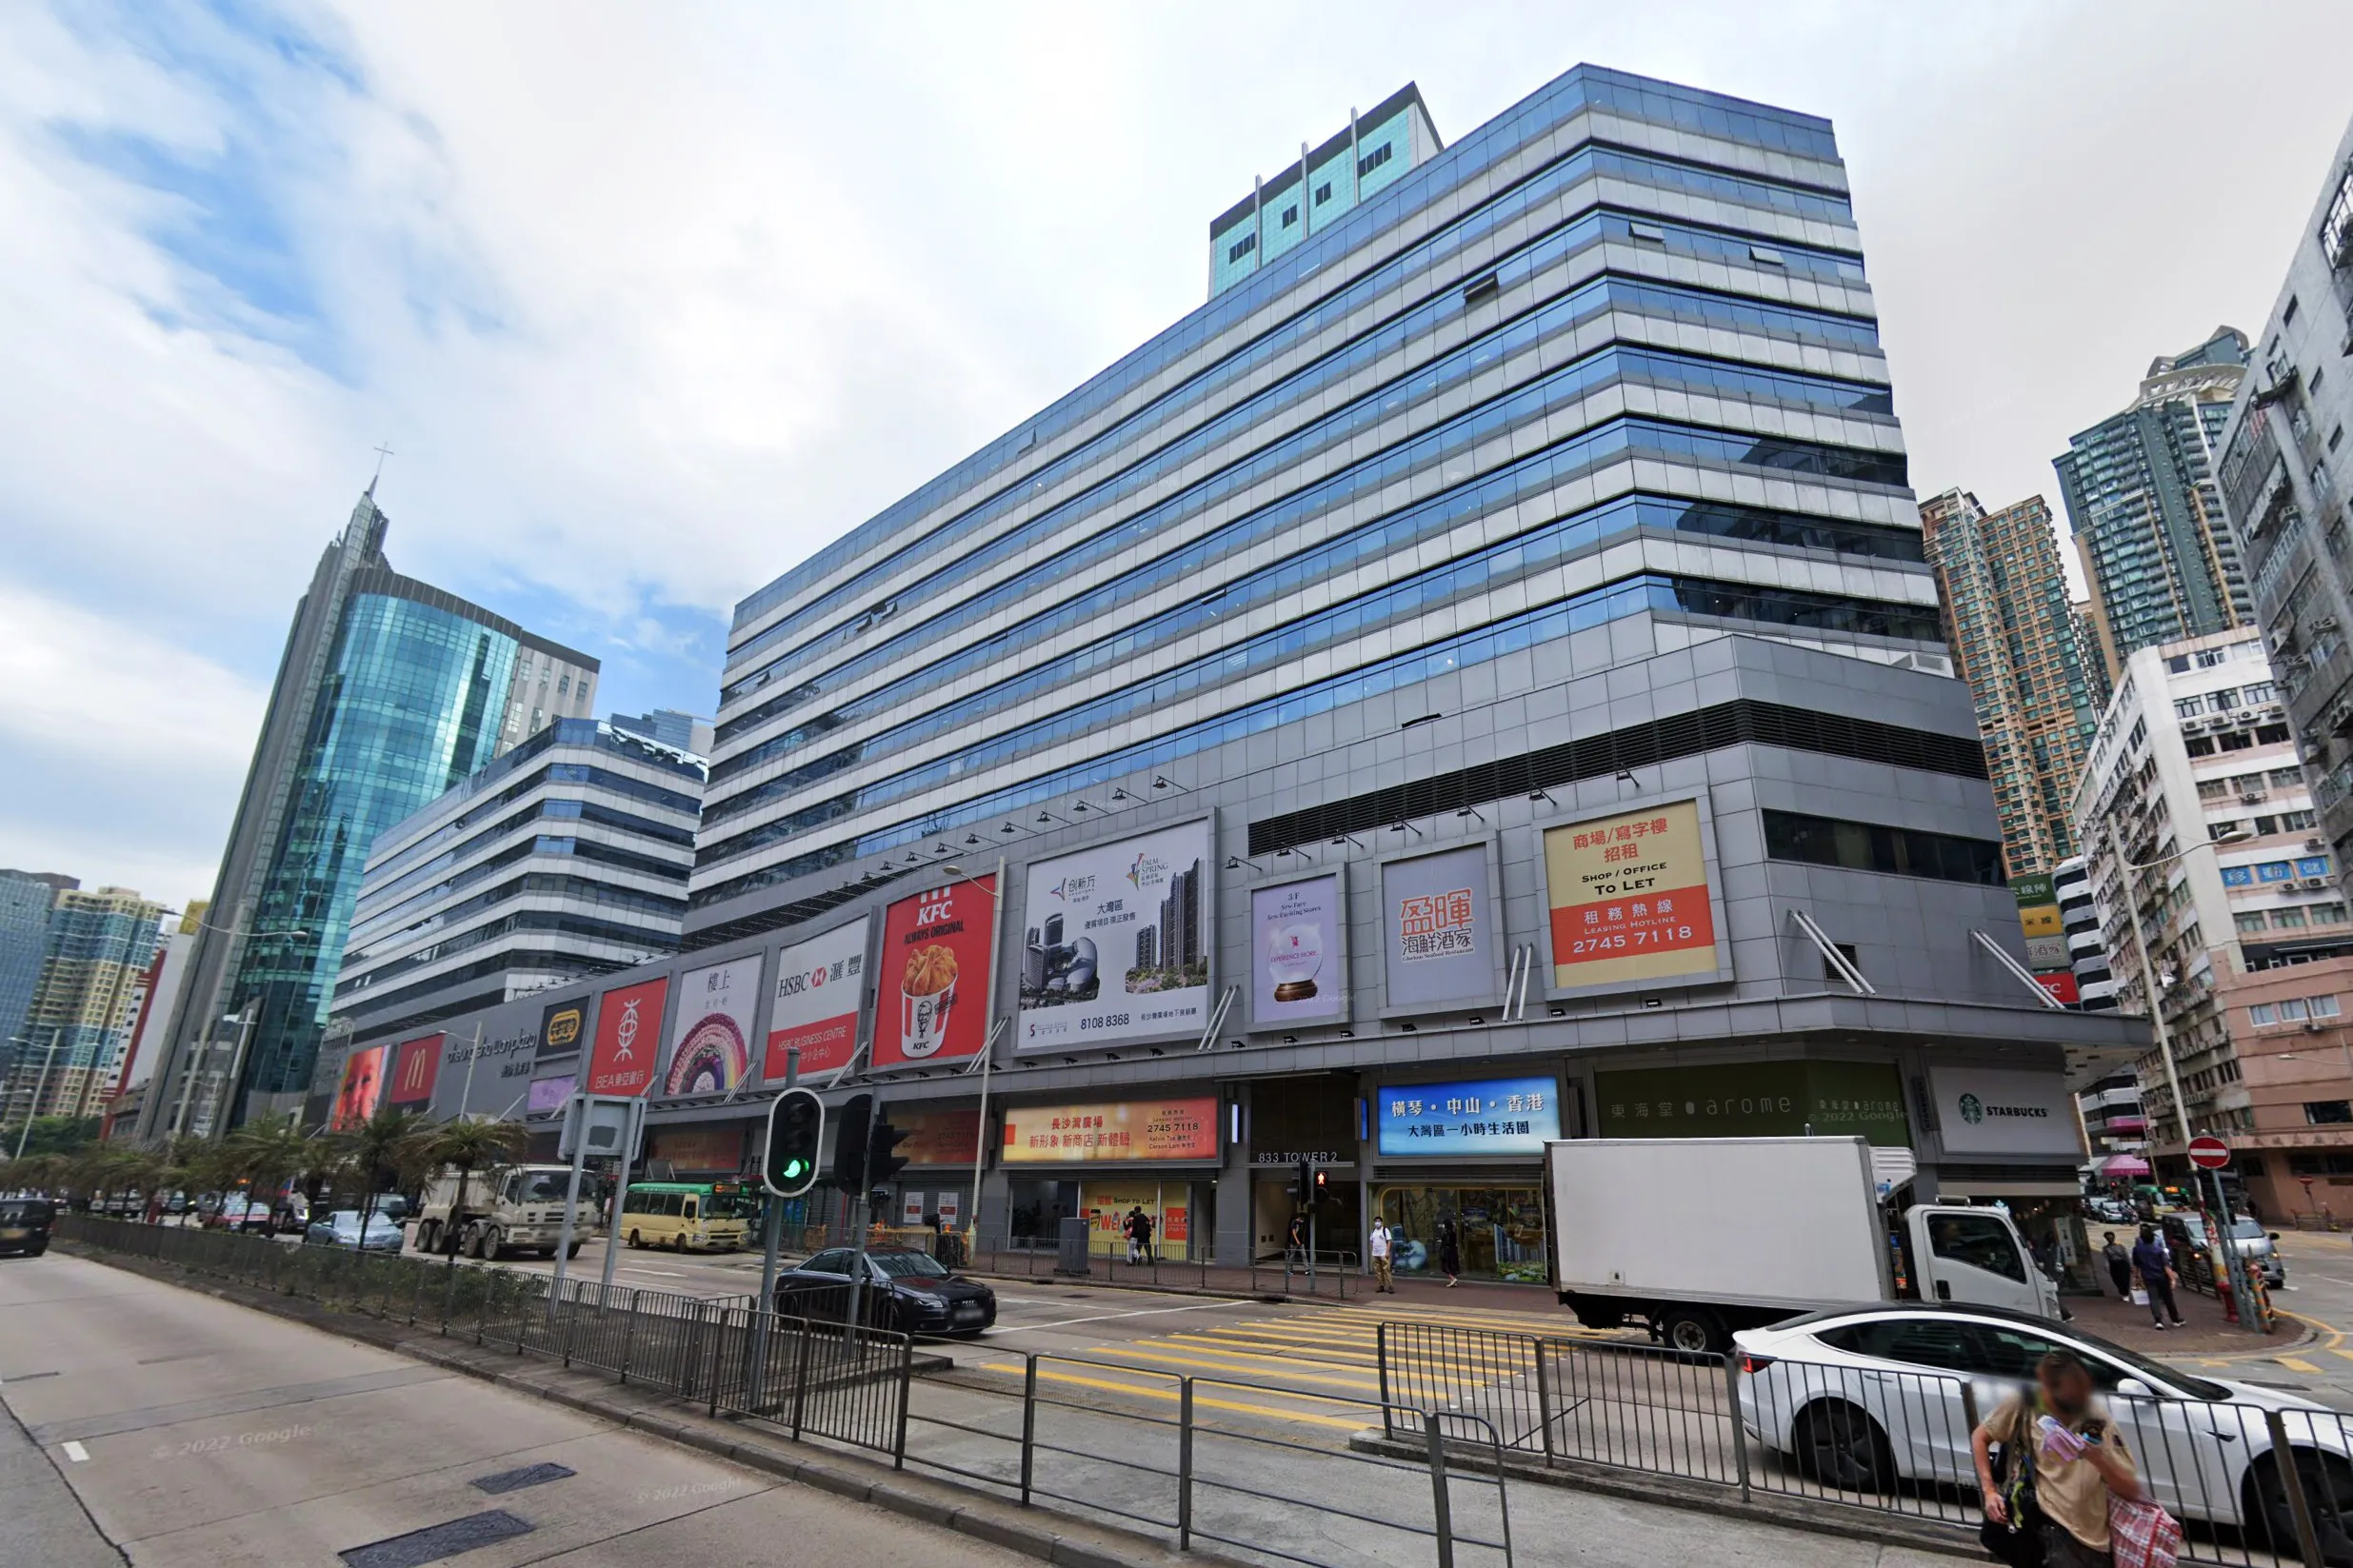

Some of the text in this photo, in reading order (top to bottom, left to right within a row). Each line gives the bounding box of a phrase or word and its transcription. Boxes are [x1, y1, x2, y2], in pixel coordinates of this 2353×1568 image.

[1573, 818, 1668, 850] 商場/寫字樓
[1604, 844, 1639, 863] 招租
[1582, 872, 1612, 883] SHOP
[1623, 862, 1666, 876] OFFICE
[1594, 878, 1655, 895] TO LET
[916, 900, 952, 926] KFC
[1097, 900, 1124, 915] 大灣區
[904, 919, 964, 944] ALWAYS ORIGINAL
[1585, 916, 1676, 935] LEASING HOTLINE
[1402, 927, 1472, 956] 海鮮酒家
[1573, 925, 1692, 953] 2745 7118
[708, 969, 730, 993] 樓上
[778, 972, 810, 998] HSBC
[1080, 1017, 1104, 1030] 8108
[1106, 1013, 1129, 1027] 8368
[823, 1025, 847, 1041] CENTRE
[913, 1042, 929, 1050] KFC
[1610, 1102, 1673, 1120] 東海堂
[1705, 1096, 1791, 1115] arome
[1986, 1105, 2048, 1118] STARBUCKS
[1051, 1116, 1104, 1130] 長沙灣廣場
[1147, 1122, 1199, 1133] 2745 7118
[1408, 1121, 1529, 1138] 大灣區一小時生活圈
[1259, 1151, 1338, 1162] 833 TOWER 2
